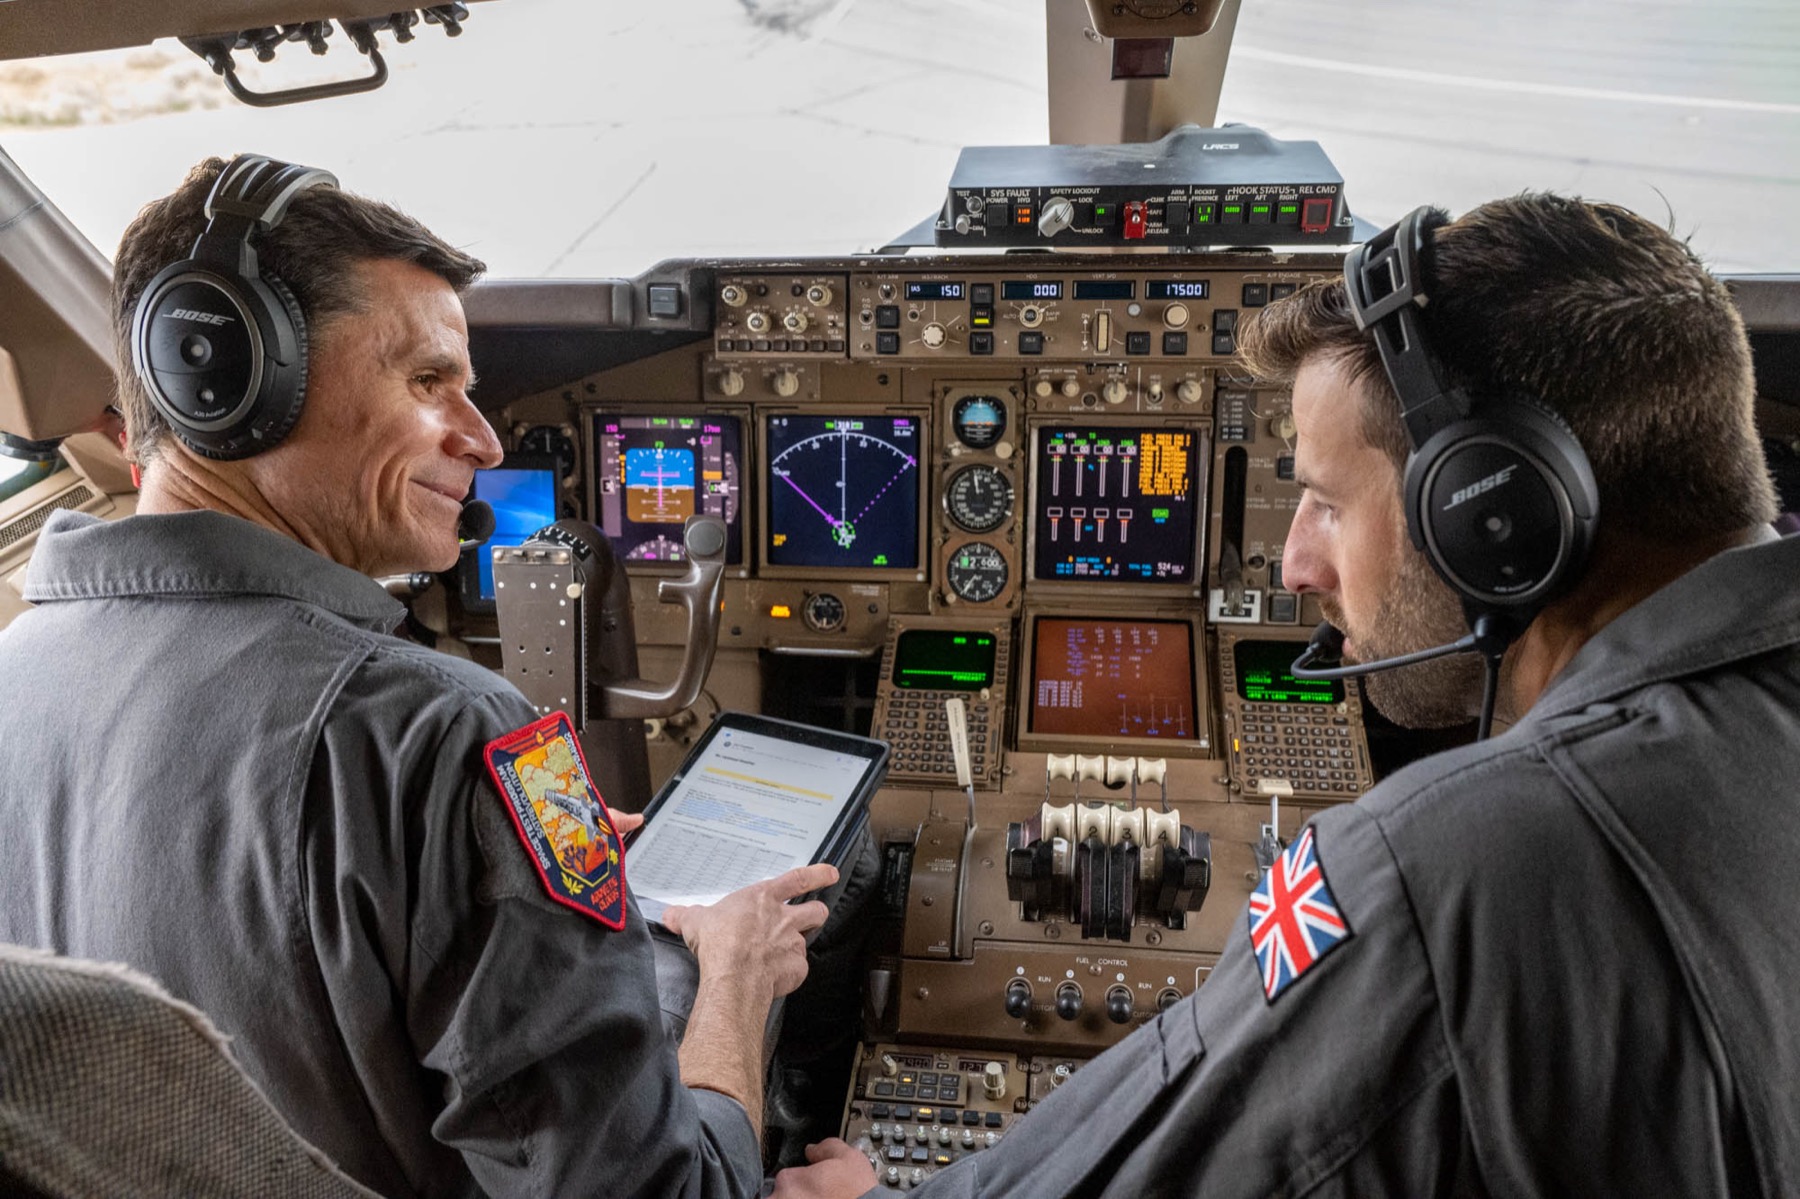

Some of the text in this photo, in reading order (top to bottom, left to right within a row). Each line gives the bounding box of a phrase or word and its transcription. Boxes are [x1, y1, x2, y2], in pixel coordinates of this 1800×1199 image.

[991, 189, 1030, 197] SYS FAULT
[1233, 187, 1290, 195] HOOK STATUS
[1300, 186, 1336, 194] REL CMD
[941, 285, 960, 297] 150
[1034, 285, 1057, 297] 000
[1166, 284, 1202, 296] 17500
[162, 308, 235, 326] BOSE
[1443, 464, 1518, 511] BOSE
[505, 761, 545, 840] SATREVOLUTION
[496, 766, 551, 871] SPACE TEST PROGRAM
[1054, 828, 1060, 837] 1
[1088, 826, 1098, 837] 2
[1122, 828, 1132, 839] 3
[1157, 830, 1168, 842] 4
[1097, 958, 1128, 967] CONTROL
[1138, 982, 1152, 990] RUN
